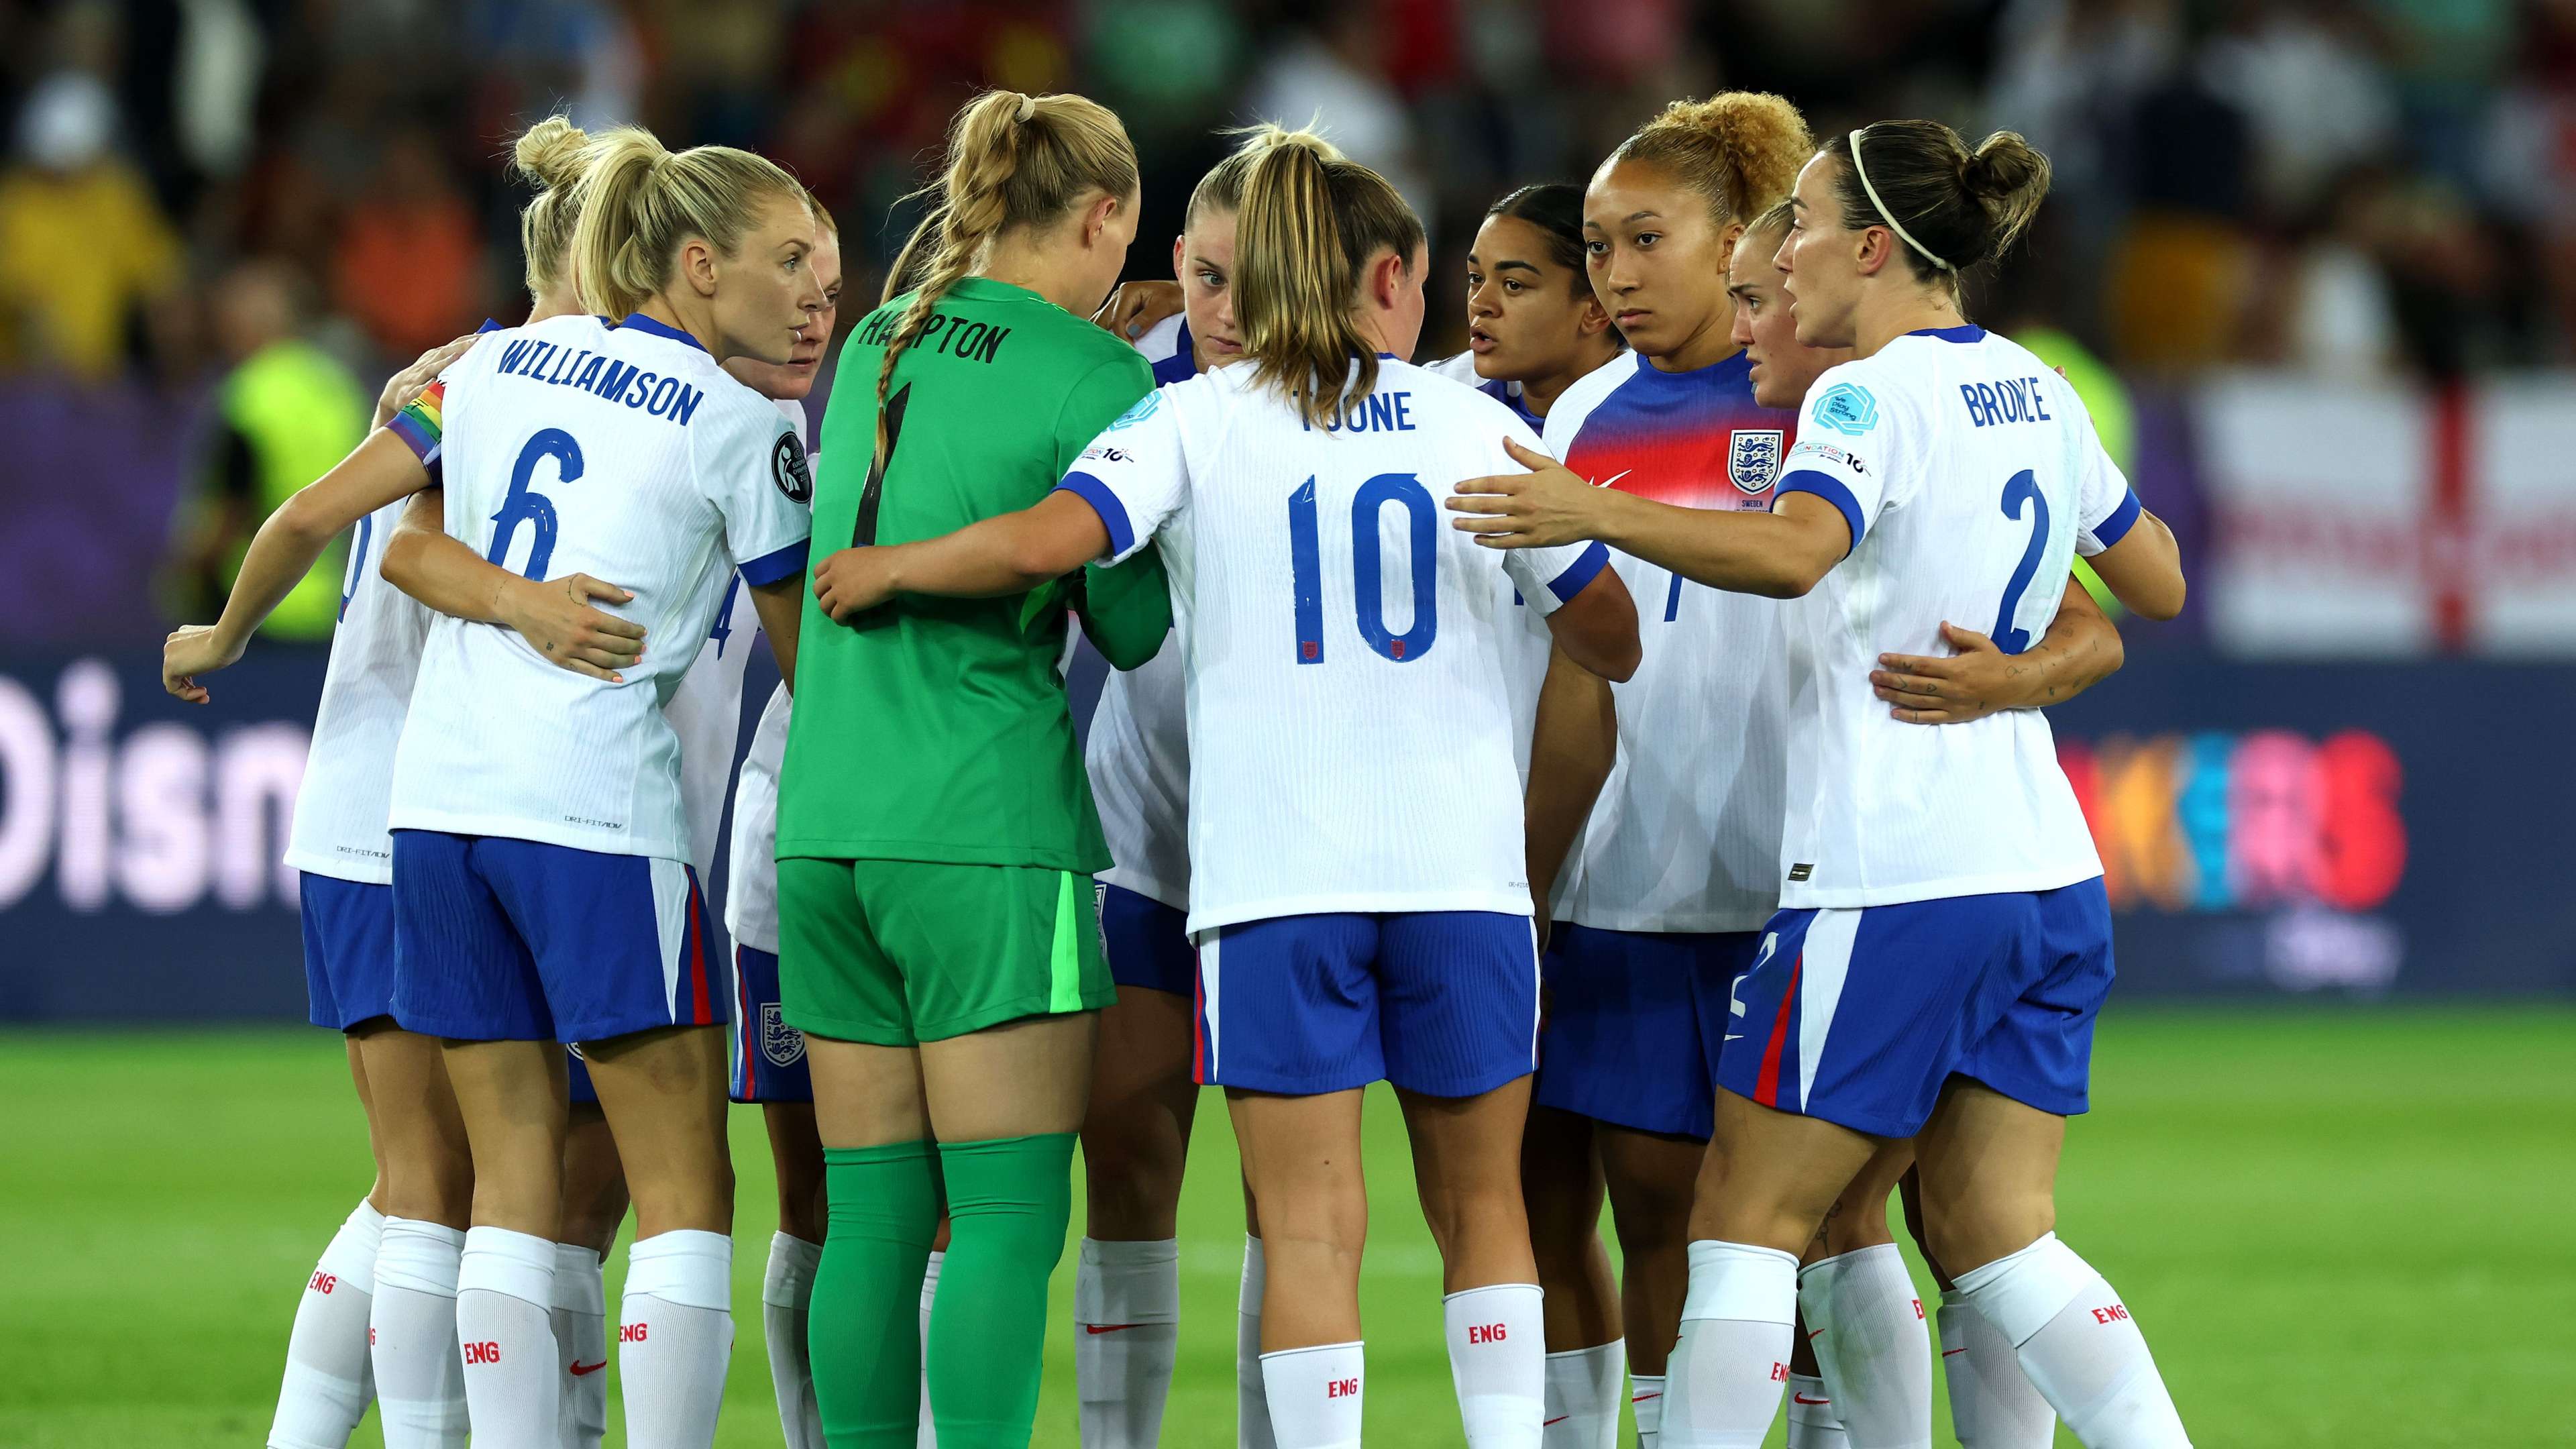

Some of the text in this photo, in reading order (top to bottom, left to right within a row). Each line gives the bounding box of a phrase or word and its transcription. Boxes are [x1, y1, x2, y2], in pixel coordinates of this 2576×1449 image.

[858, 311, 1012, 364] HAPTON
[497, 339, 704, 427] WILLIAMSON
[488, 427, 584, 582] 6
[1741, 499, 1764, 508] SWEDEN
[1288, 474, 1437, 665] 10
[1991, 470, 2049, 655] 2
[310, 1271, 336, 1295] ENG
[2091, 1304, 2128, 1324] ENG
[619, 1323, 647, 1342] ENG
[1468, 1323, 1507, 1344] ENG
[464, 1342, 500, 1364] ENG
[1328, 1378, 1358, 1399] ENG
